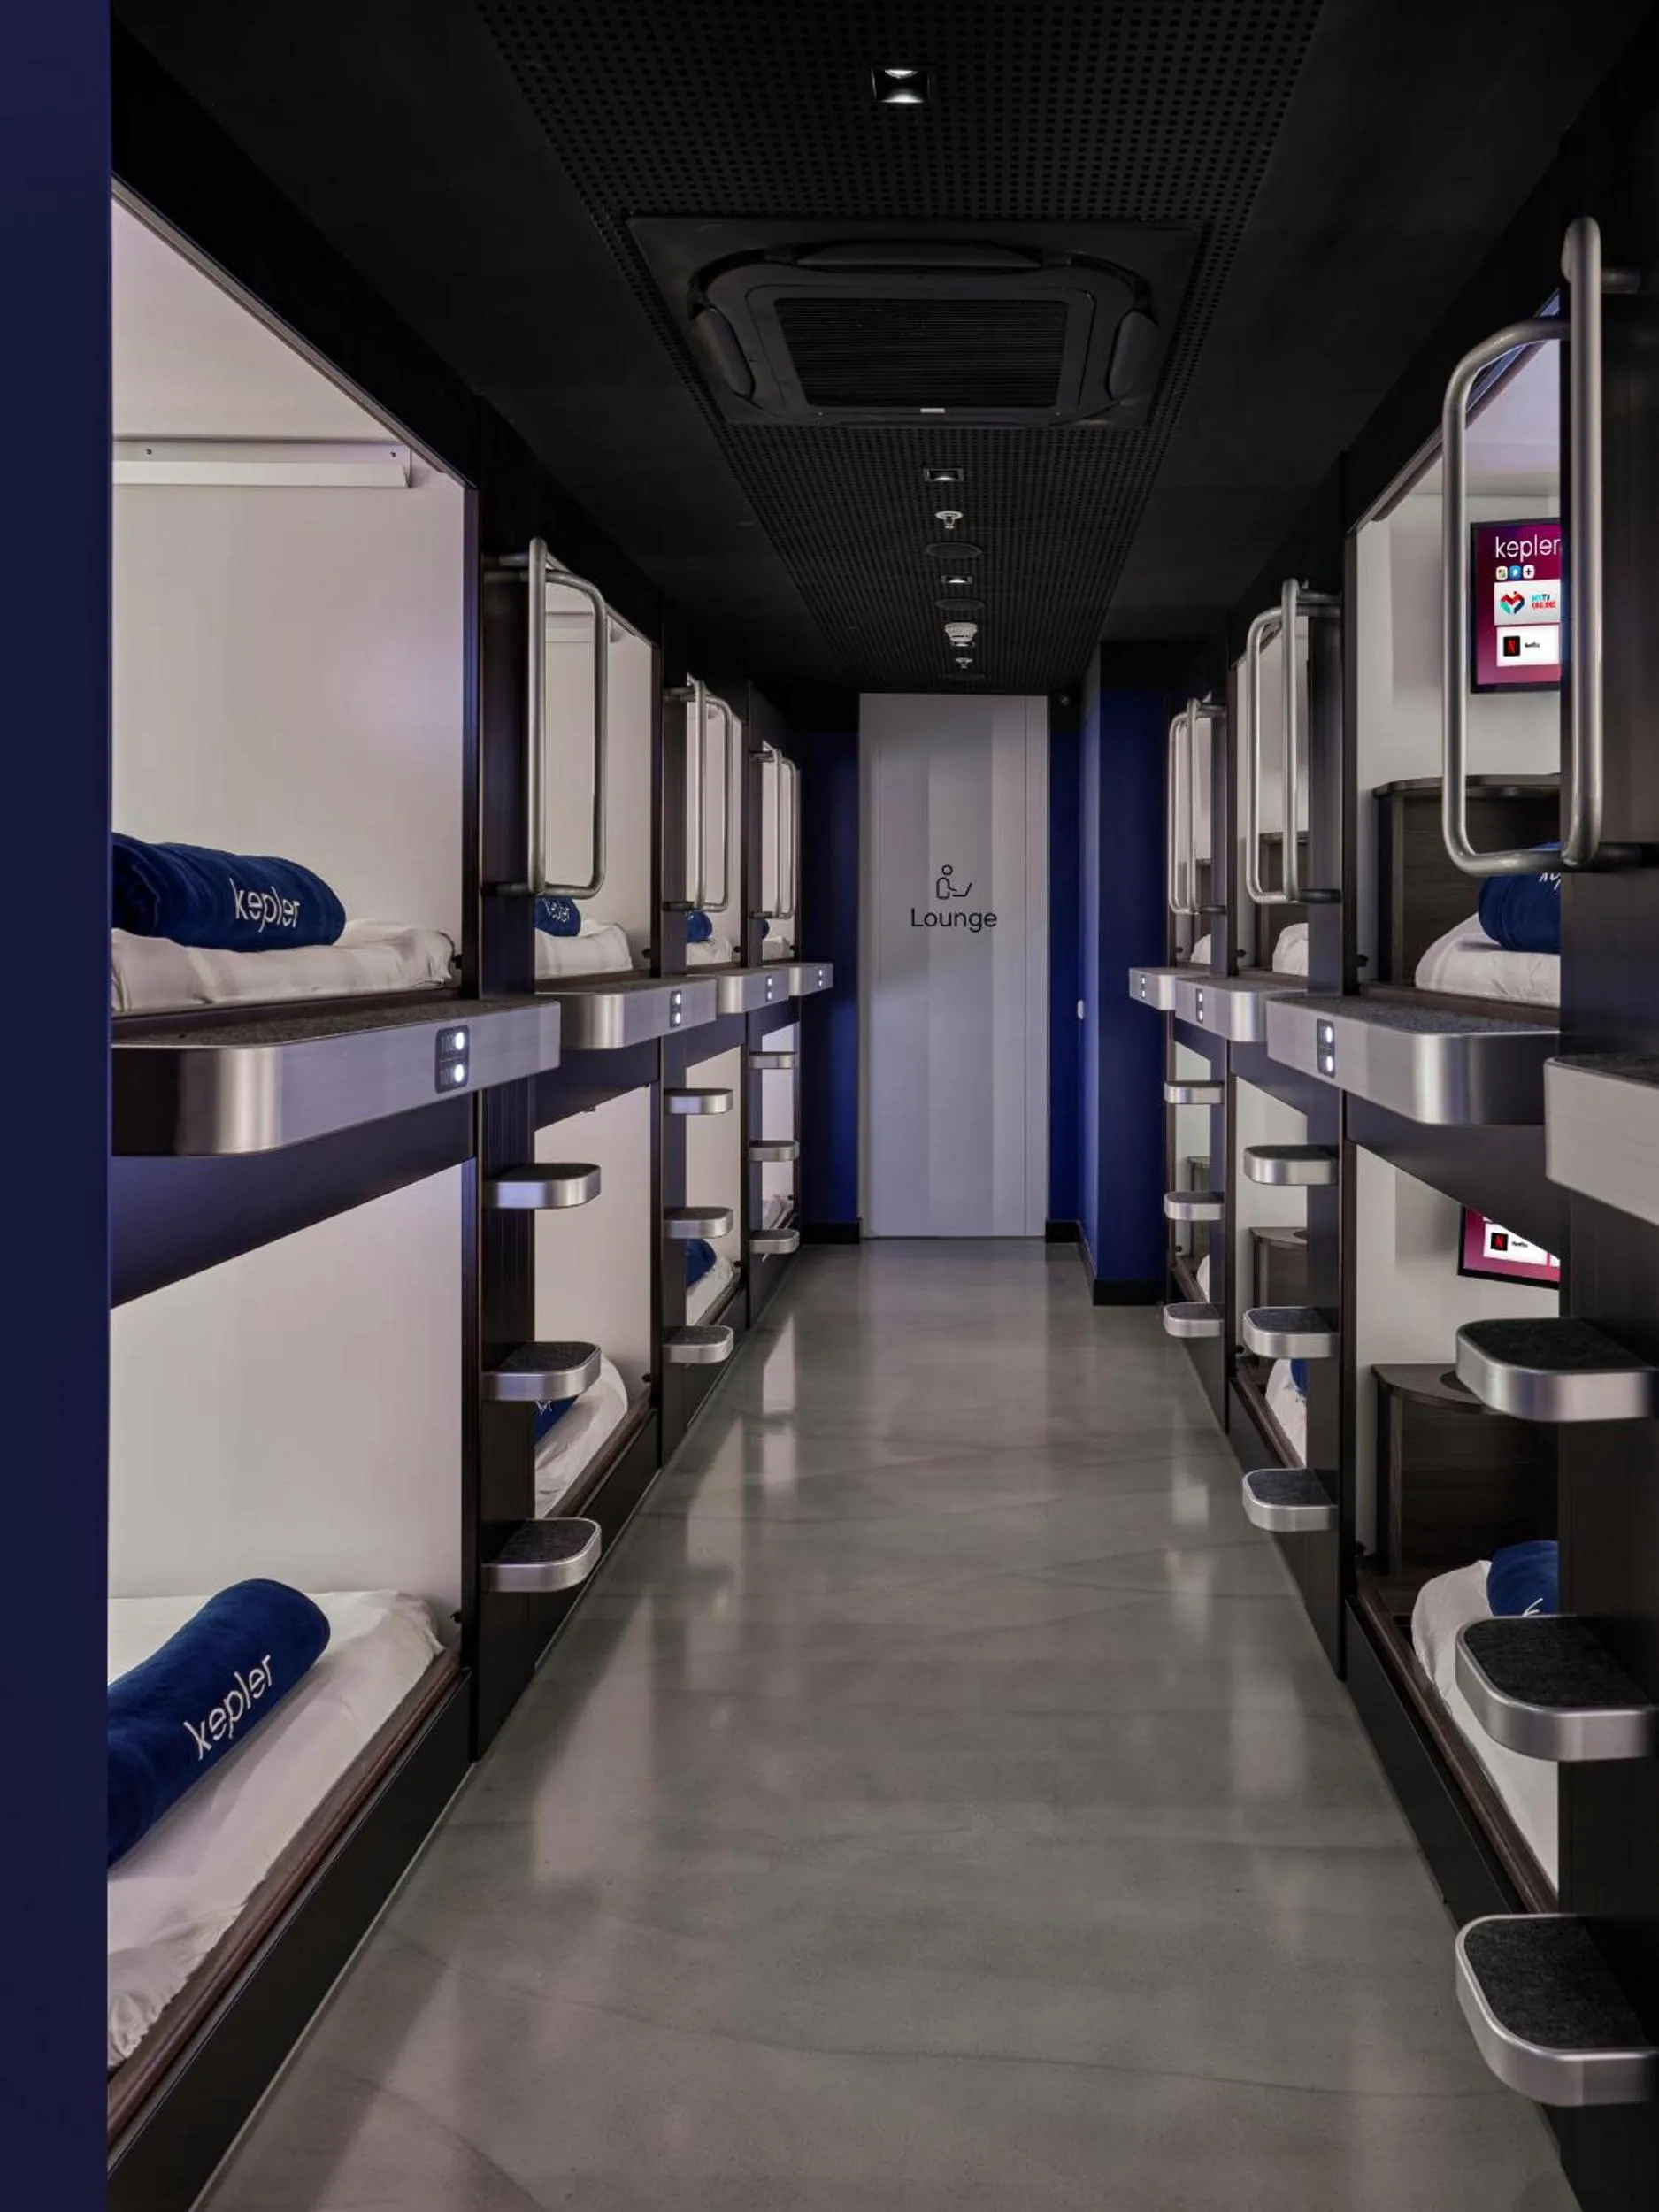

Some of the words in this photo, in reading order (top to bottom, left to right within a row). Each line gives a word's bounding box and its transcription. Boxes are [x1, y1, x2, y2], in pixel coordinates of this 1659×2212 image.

[1495, 534, 1561, 563] kepler
[228, 877, 301, 933] kepler
[911, 907, 997, 933] Lounge
[183, 1654, 273, 1762] kepler
